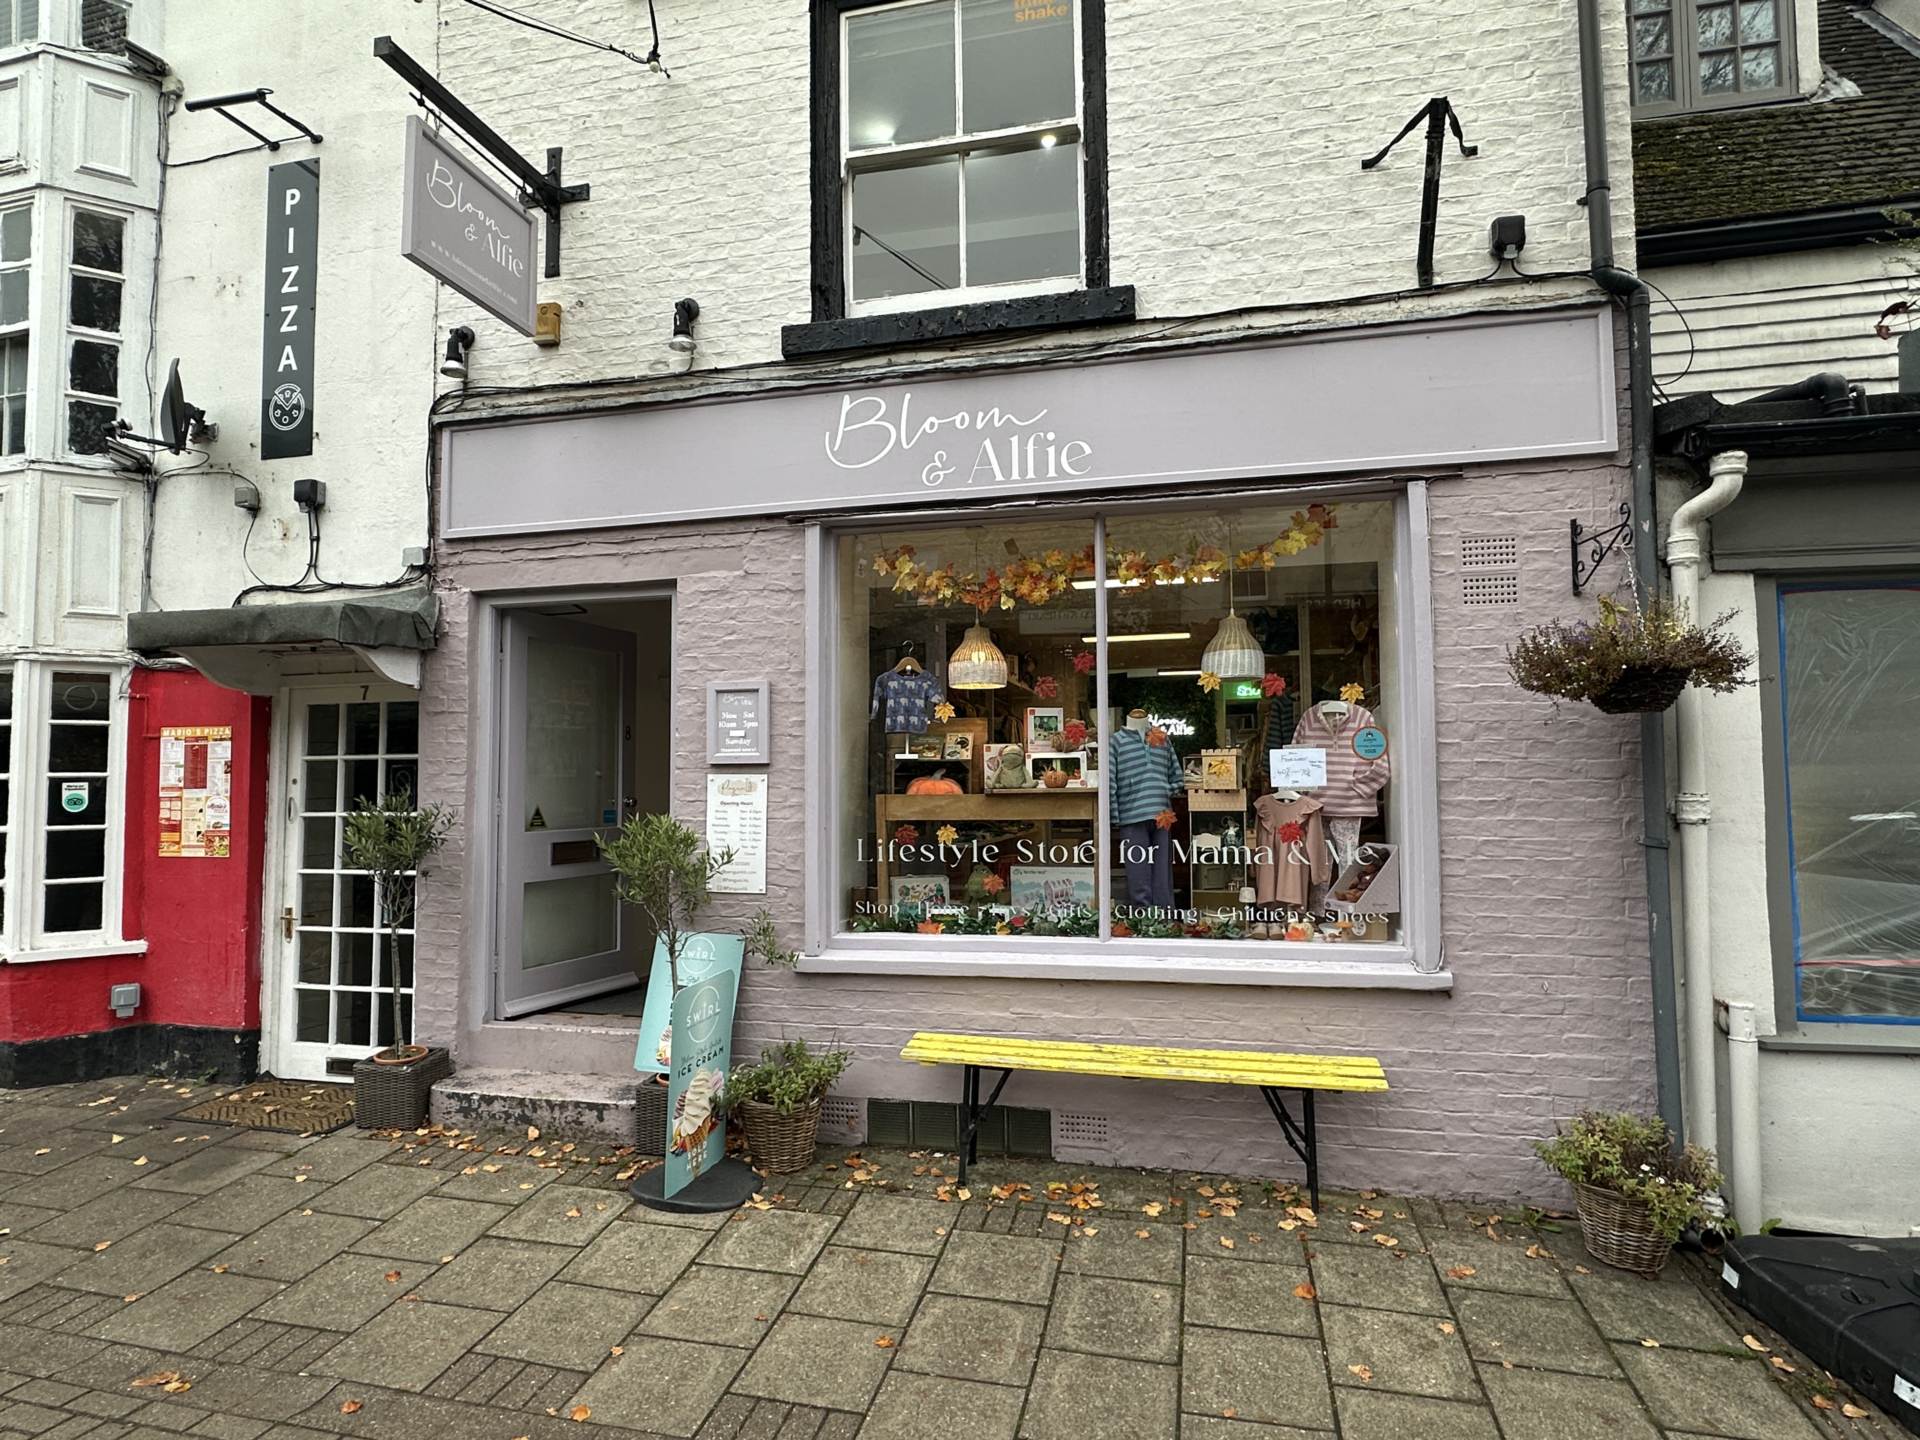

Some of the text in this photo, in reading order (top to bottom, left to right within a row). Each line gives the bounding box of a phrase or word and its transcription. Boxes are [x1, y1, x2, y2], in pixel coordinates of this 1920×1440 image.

[1015, 4, 1069, 22] shake
[426, 158, 511, 239] Bloom
[464, 223, 478, 242] &
[481, 232, 524, 278] Alfie
[276, 187, 302, 373] PIZZA
[824, 391, 1049, 469] Bloom
[921, 430, 1094, 487] & Alfie
[360, 684, 370, 700] 7
[204, 727, 230, 736] PIZZA
[725, 738, 752, 746] Sunday
[856, 838, 1375, 868] Lifestyle Store for Mama & Me
[855, 900, 900, 918] Shop
[1114, 904, 1198, 925] Clothing
[1325, 908, 1390, 923] shoes
[677, 1063, 692, 1079] ICE
[695, 1045, 724, 1067] CREAM
